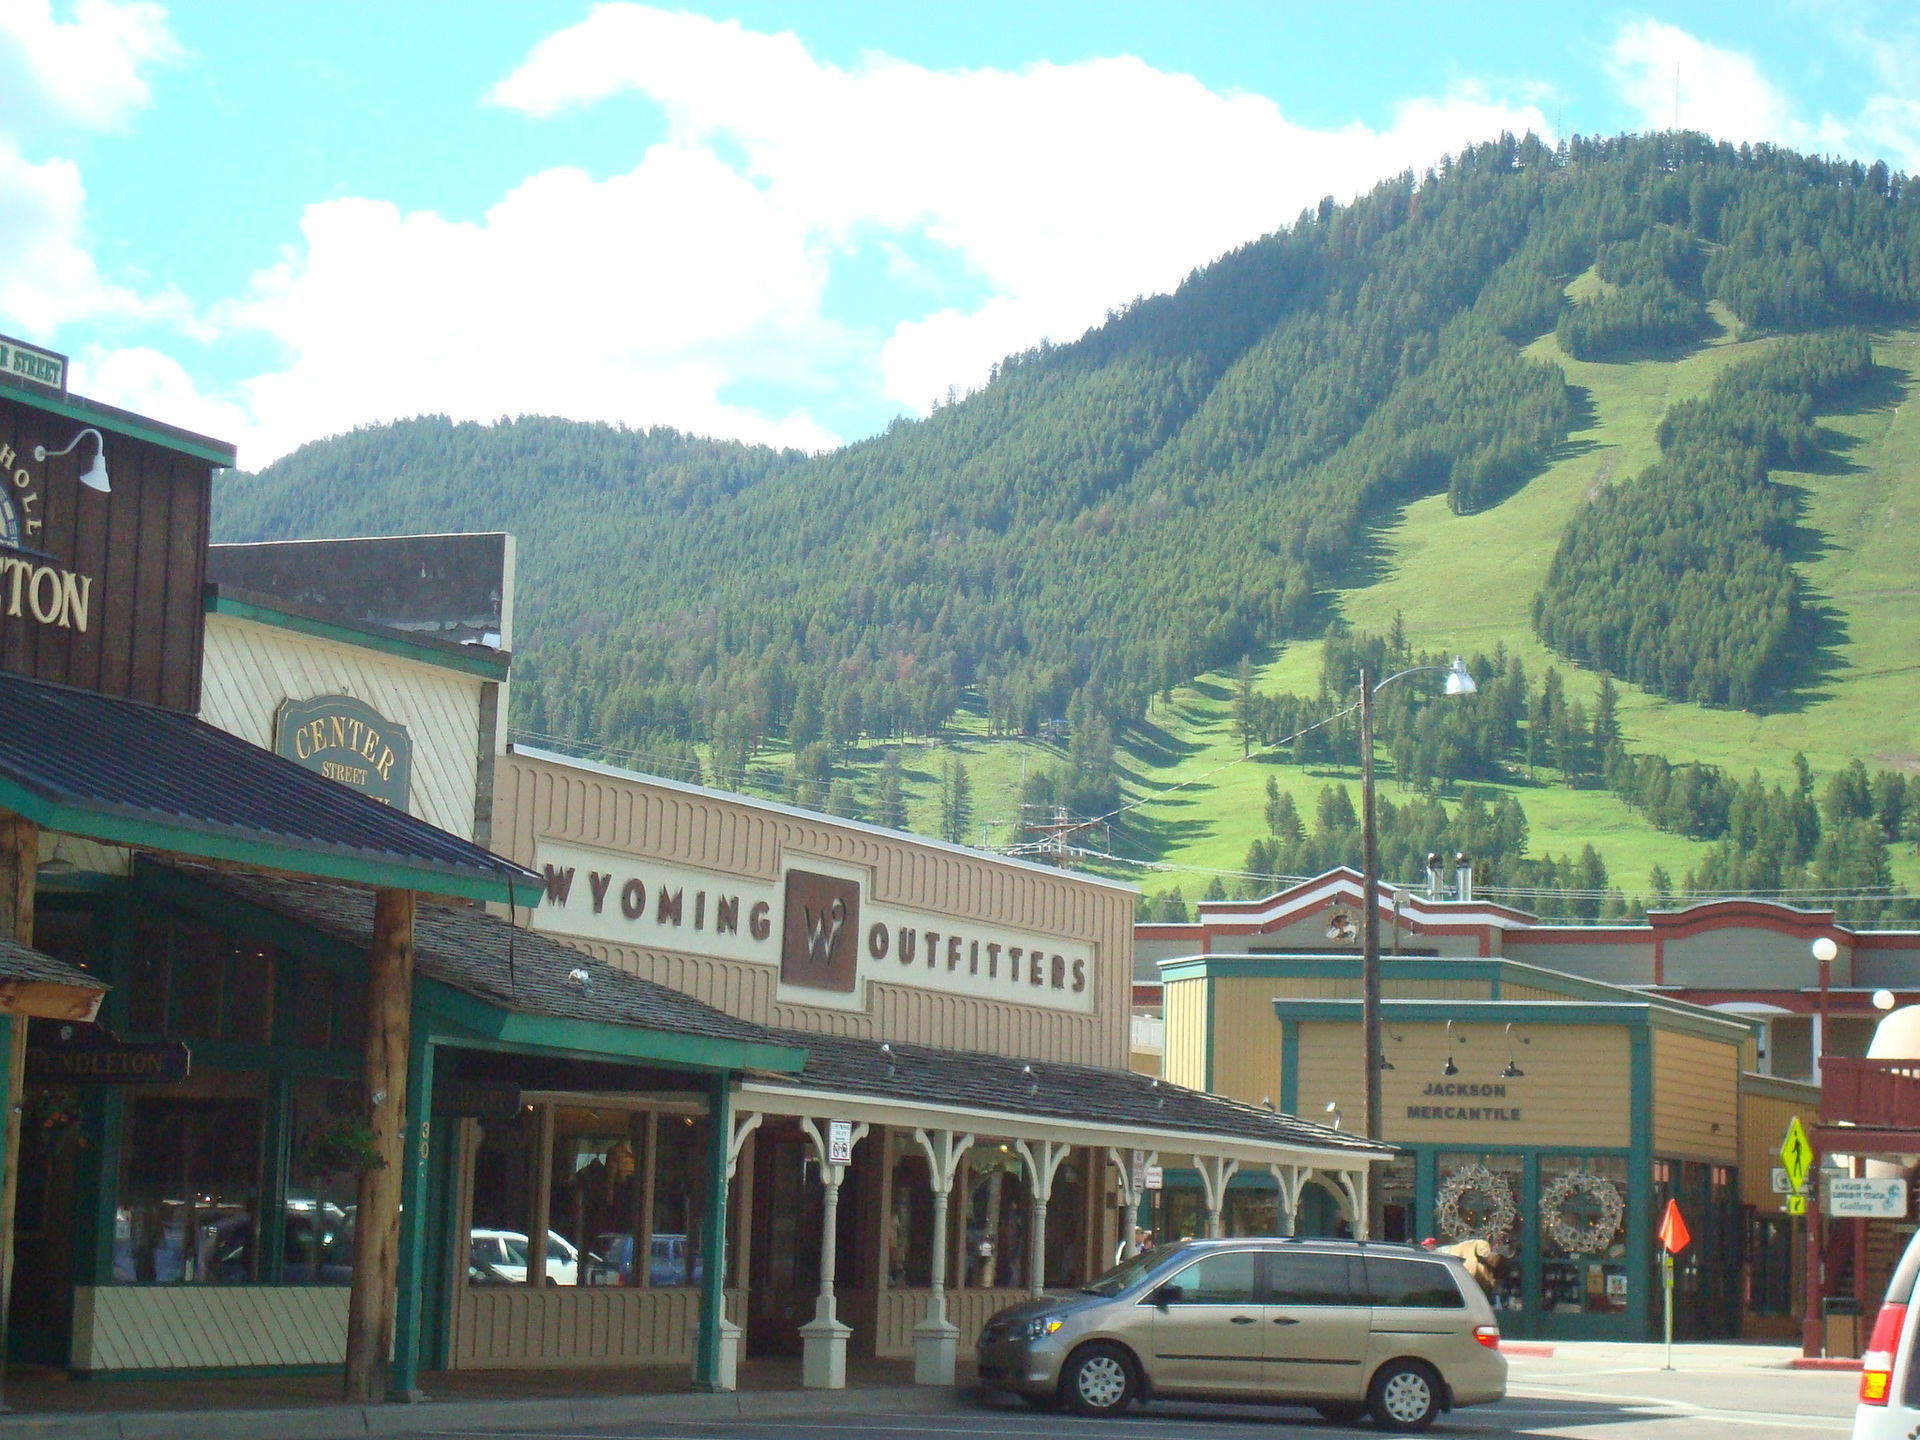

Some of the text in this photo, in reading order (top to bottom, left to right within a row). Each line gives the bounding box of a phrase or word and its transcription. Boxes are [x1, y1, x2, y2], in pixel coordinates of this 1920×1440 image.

[13, 350, 61, 385] STREET
[0, 557, 92, 633] TON
[296, 715, 395, 782] CENTER
[321, 760, 369, 786] STREET
[544, 863, 771, 941] WYOMING
[869, 922, 1086, 993] OUTFITTERS
[1407, 1105, 1522, 1122] MERCANTILE
[1422, 1083, 1507, 1098] JACKSON
